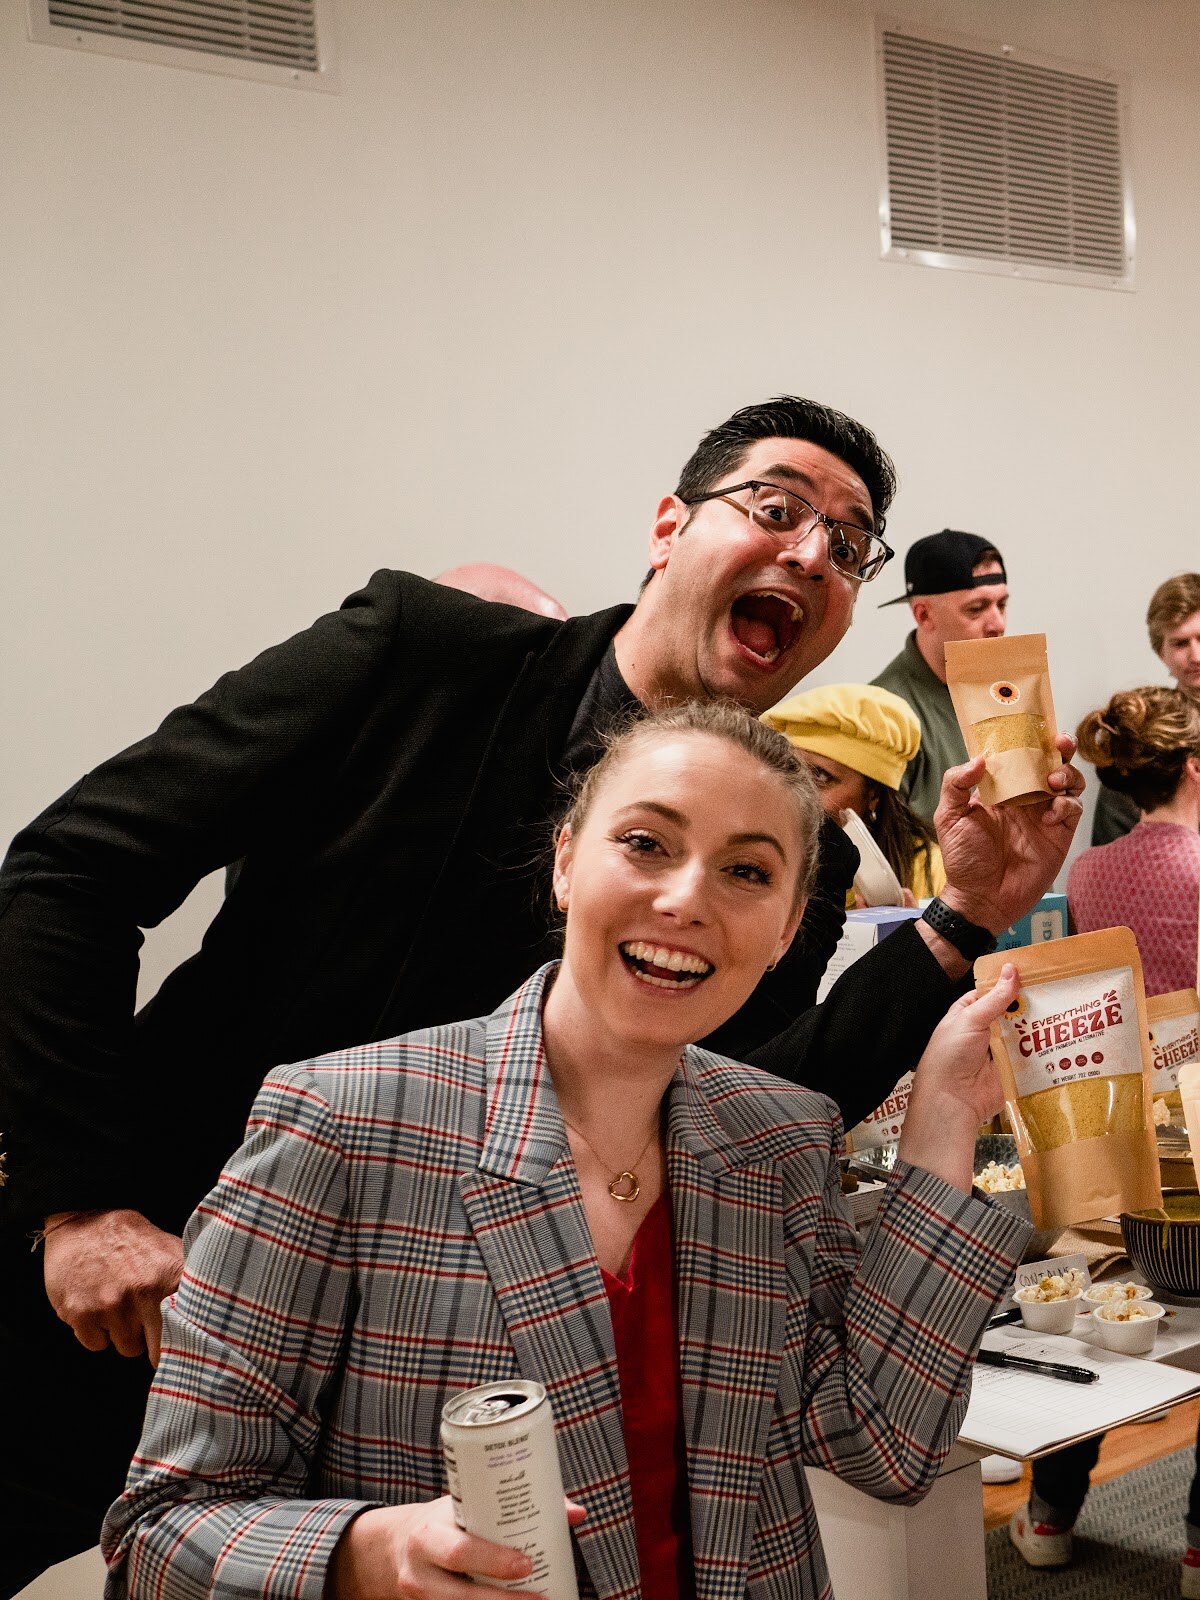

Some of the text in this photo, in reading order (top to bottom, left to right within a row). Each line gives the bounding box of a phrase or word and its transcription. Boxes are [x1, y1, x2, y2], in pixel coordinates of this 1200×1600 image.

[1032, 1000, 1101, 1029] EVERYTHING
[1019, 1003, 1123, 1057] CHEEZE
[508, 1433, 529, 1447] BLEND
